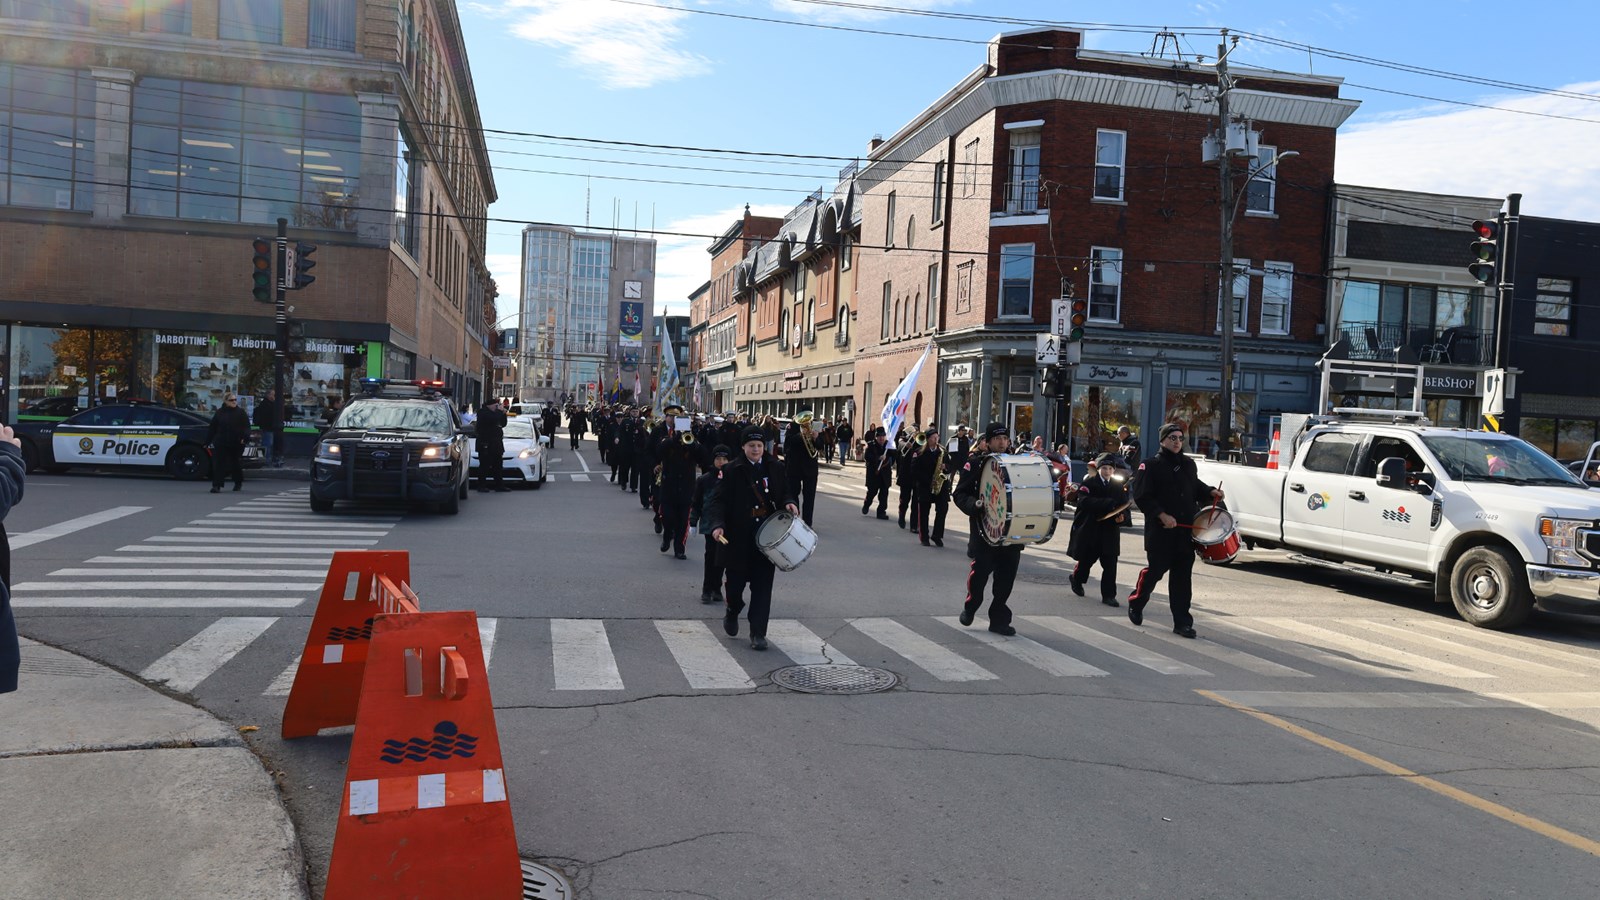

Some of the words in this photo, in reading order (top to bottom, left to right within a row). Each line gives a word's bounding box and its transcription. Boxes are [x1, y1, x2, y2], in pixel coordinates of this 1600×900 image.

[155, 333, 207, 346] BARBOTTINE
[306, 342, 355, 354] BARBOTTINE
[101, 439, 160, 456] Police
